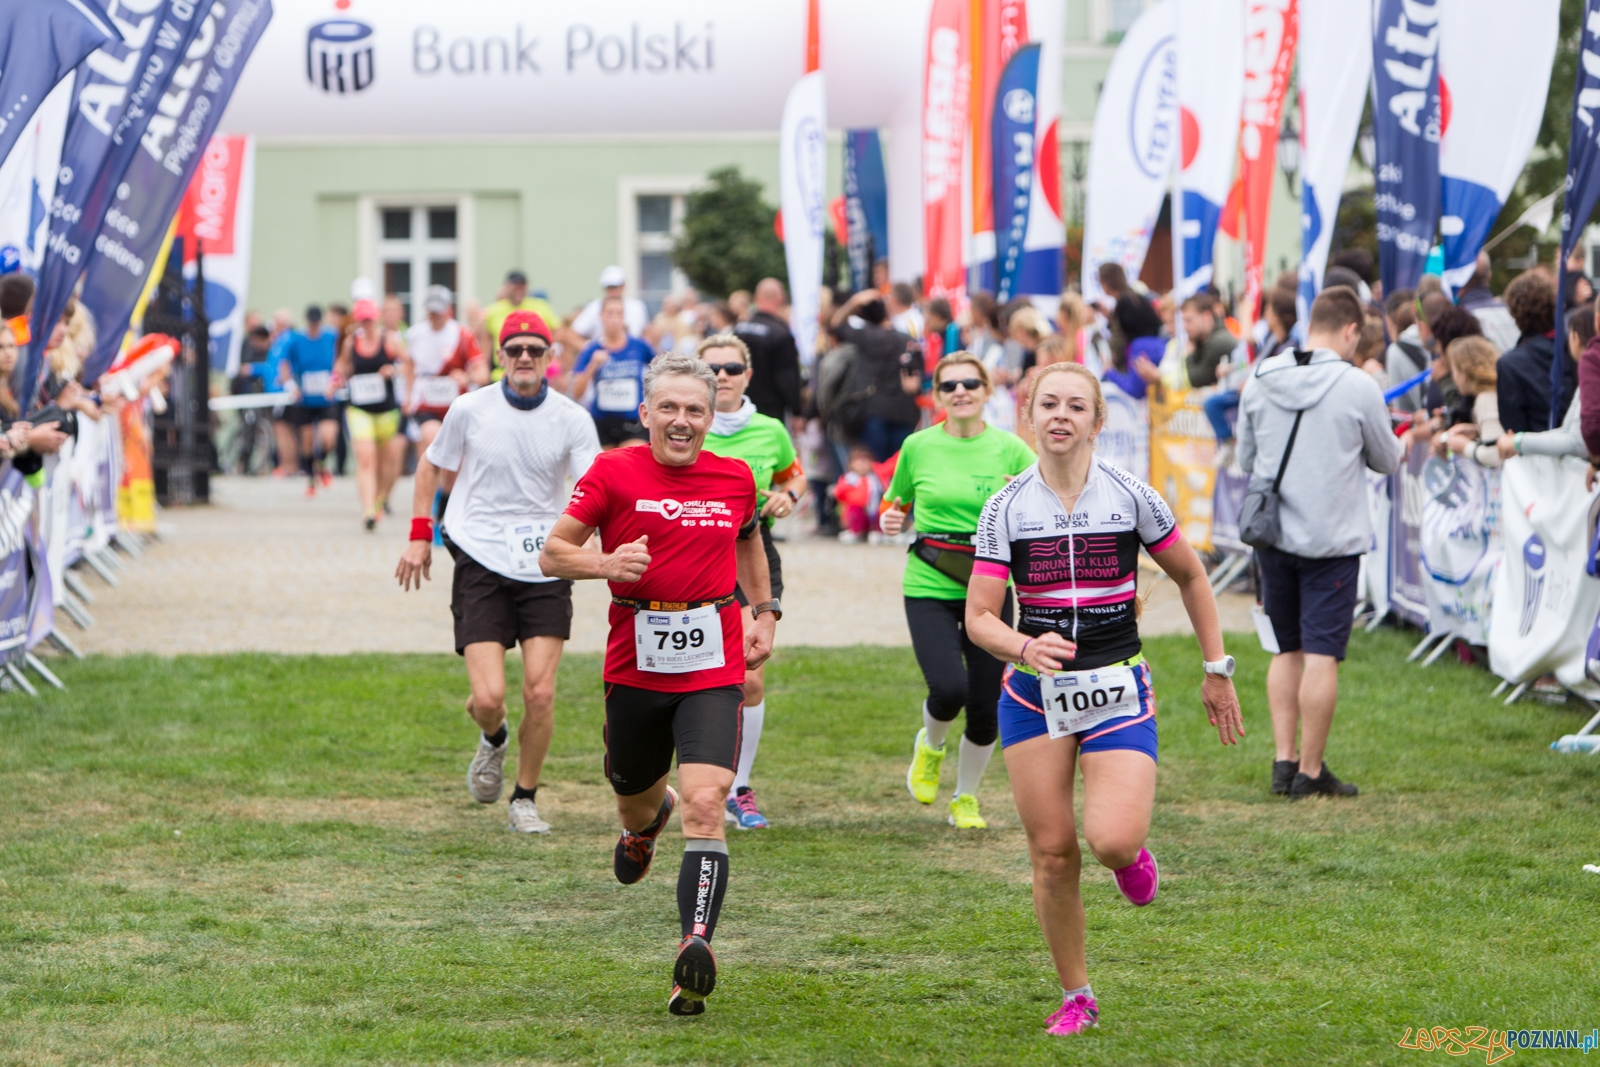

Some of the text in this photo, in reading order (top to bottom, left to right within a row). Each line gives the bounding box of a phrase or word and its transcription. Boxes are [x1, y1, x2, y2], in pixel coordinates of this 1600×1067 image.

[412, 21, 714, 75] Bank Polski
[683, 500, 726, 509] CHALLENGE
[986, 478, 1021, 556] TRIATHLONOWY
[1029, 555, 1119, 572] TORUŃSKI KLUB
[1027, 567, 1120, 583] TRIATHLONOWY
[654, 628, 704, 650] 799
[1055, 685, 1125, 713] 1007
